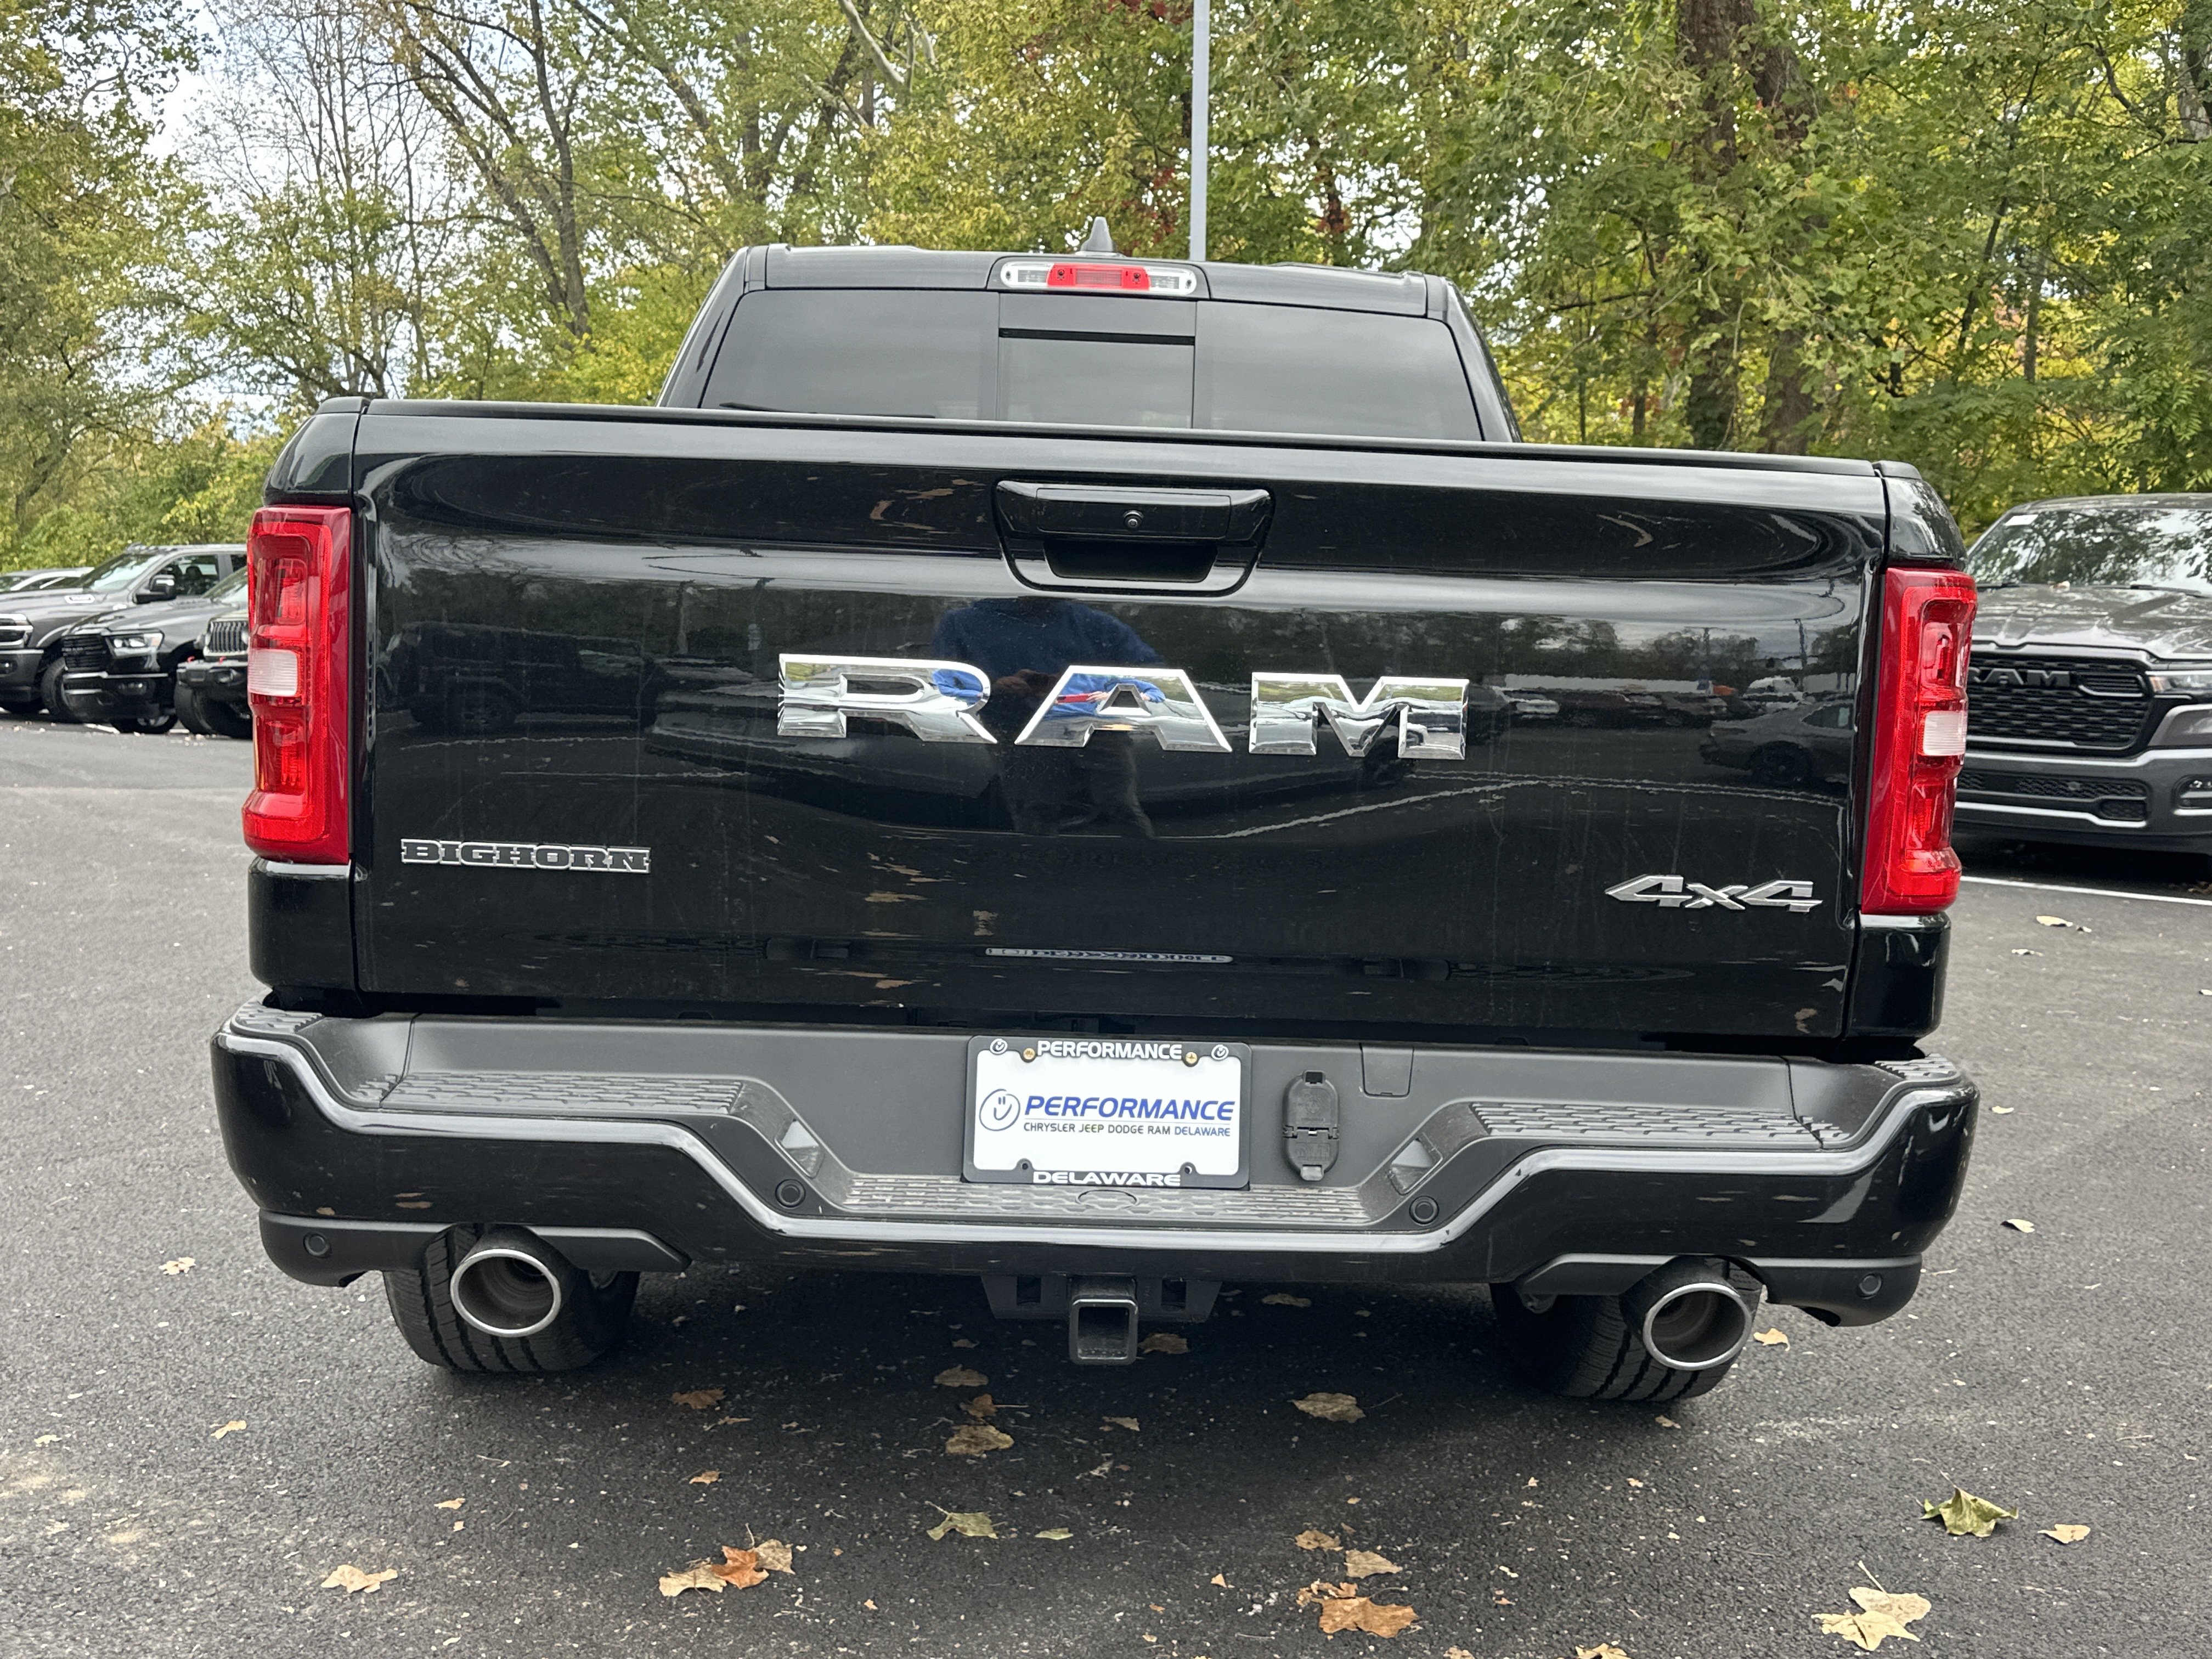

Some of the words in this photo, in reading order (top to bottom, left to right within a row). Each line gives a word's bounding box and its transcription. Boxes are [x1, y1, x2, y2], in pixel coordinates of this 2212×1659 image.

[777, 653, 1469, 760] RAM
[401, 838, 652, 874] BIGHORN
[1605, 874, 1823, 913] 4x4
[1037, 1040, 1183, 1060] PERFORMANCE
[1024, 1096, 1235, 1121] PERFORMANCE
[1023, 1122, 1075, 1133] CHRYSLER
[1079, 1123, 1104, 1133] JEEP
[1108, 1124, 1144, 1135] DODGE
[1148, 1126, 1171, 1135] RAM
[1175, 1126, 1231, 1137] DELAWARE
[1032, 1171, 1181, 1186] DELAWARE
